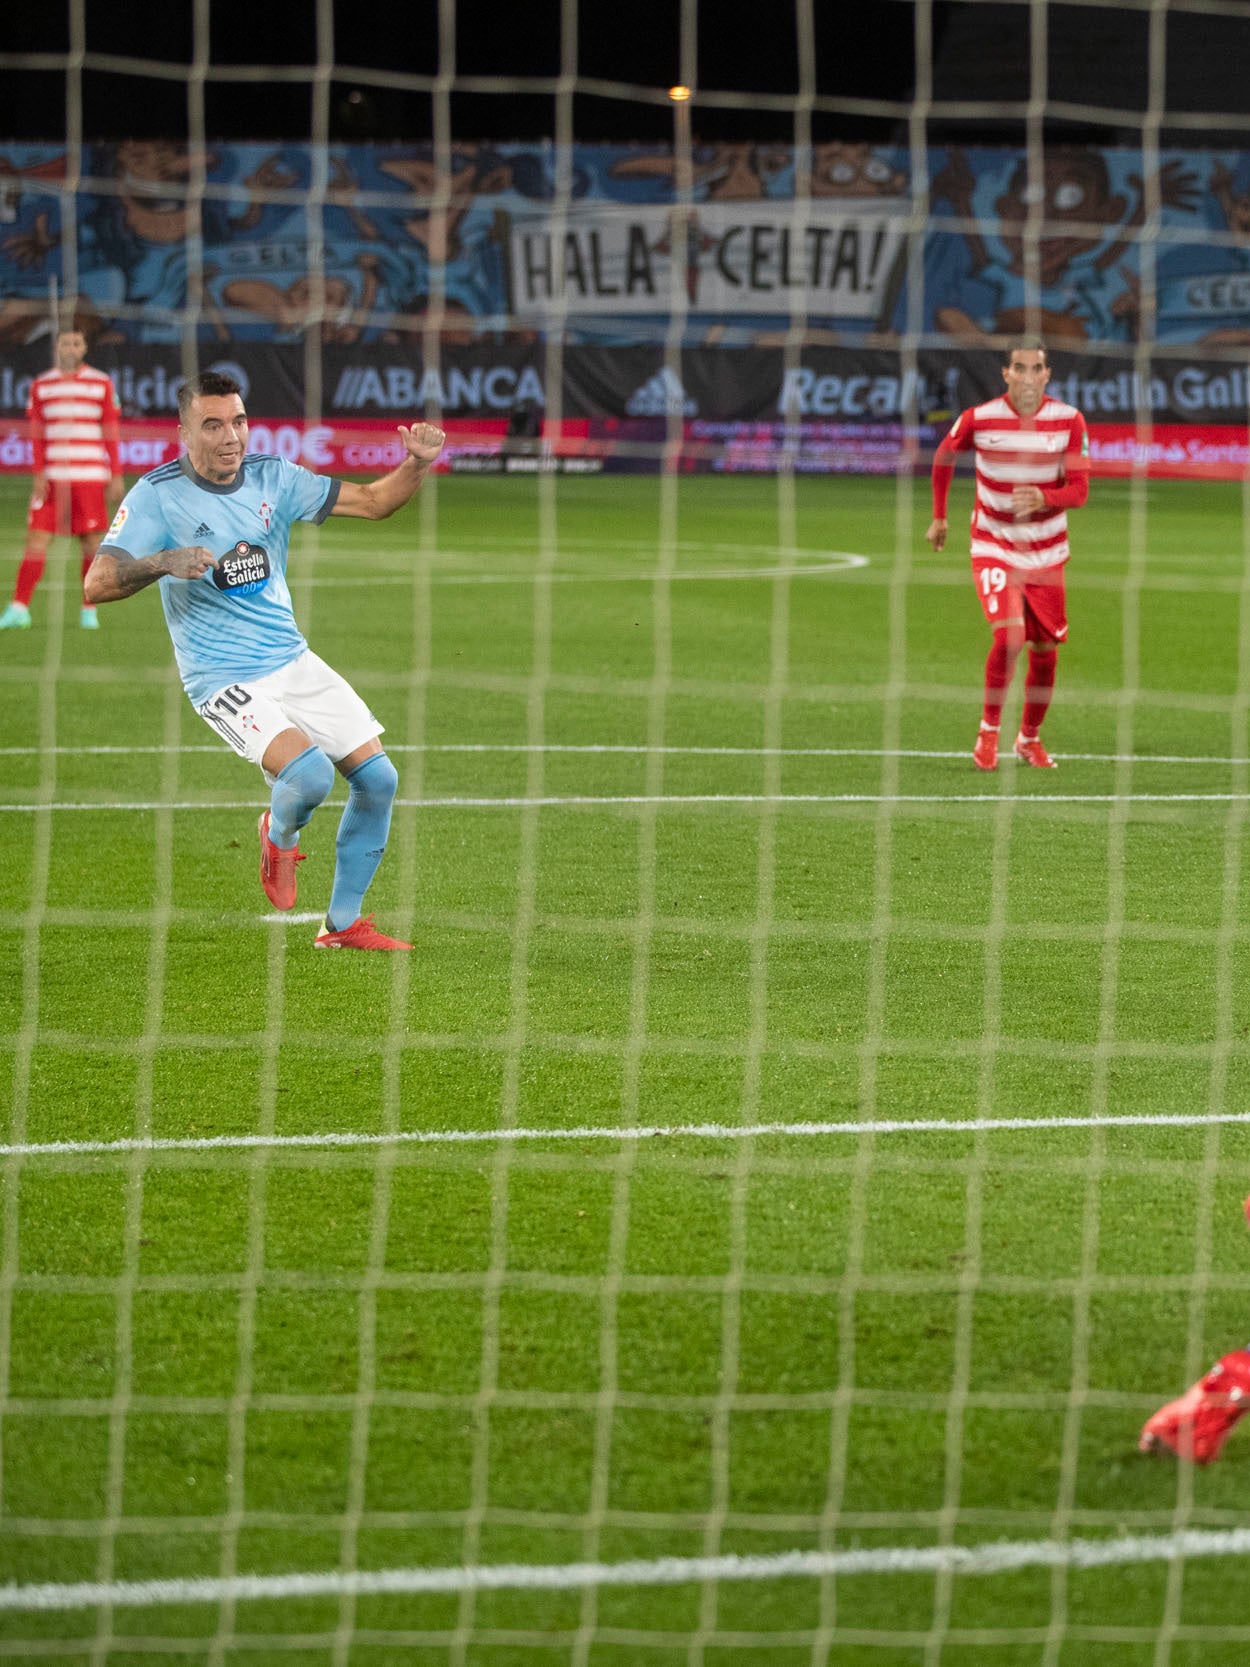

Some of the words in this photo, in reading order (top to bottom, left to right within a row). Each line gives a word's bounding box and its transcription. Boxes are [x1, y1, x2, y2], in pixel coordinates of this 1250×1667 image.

[230, 245, 338, 265] CELA
[522, 222, 656, 300] HALA
[716, 223, 887, 294] CELTA!
[353, 365, 545, 409] ABANCA
[1046, 369, 1170, 411] strella
[223, 553, 264, 573] Estrella
[226, 566, 266, 586] Galicia
[980, 567, 1007, 595] 19
[214, 684, 253, 716] 10
